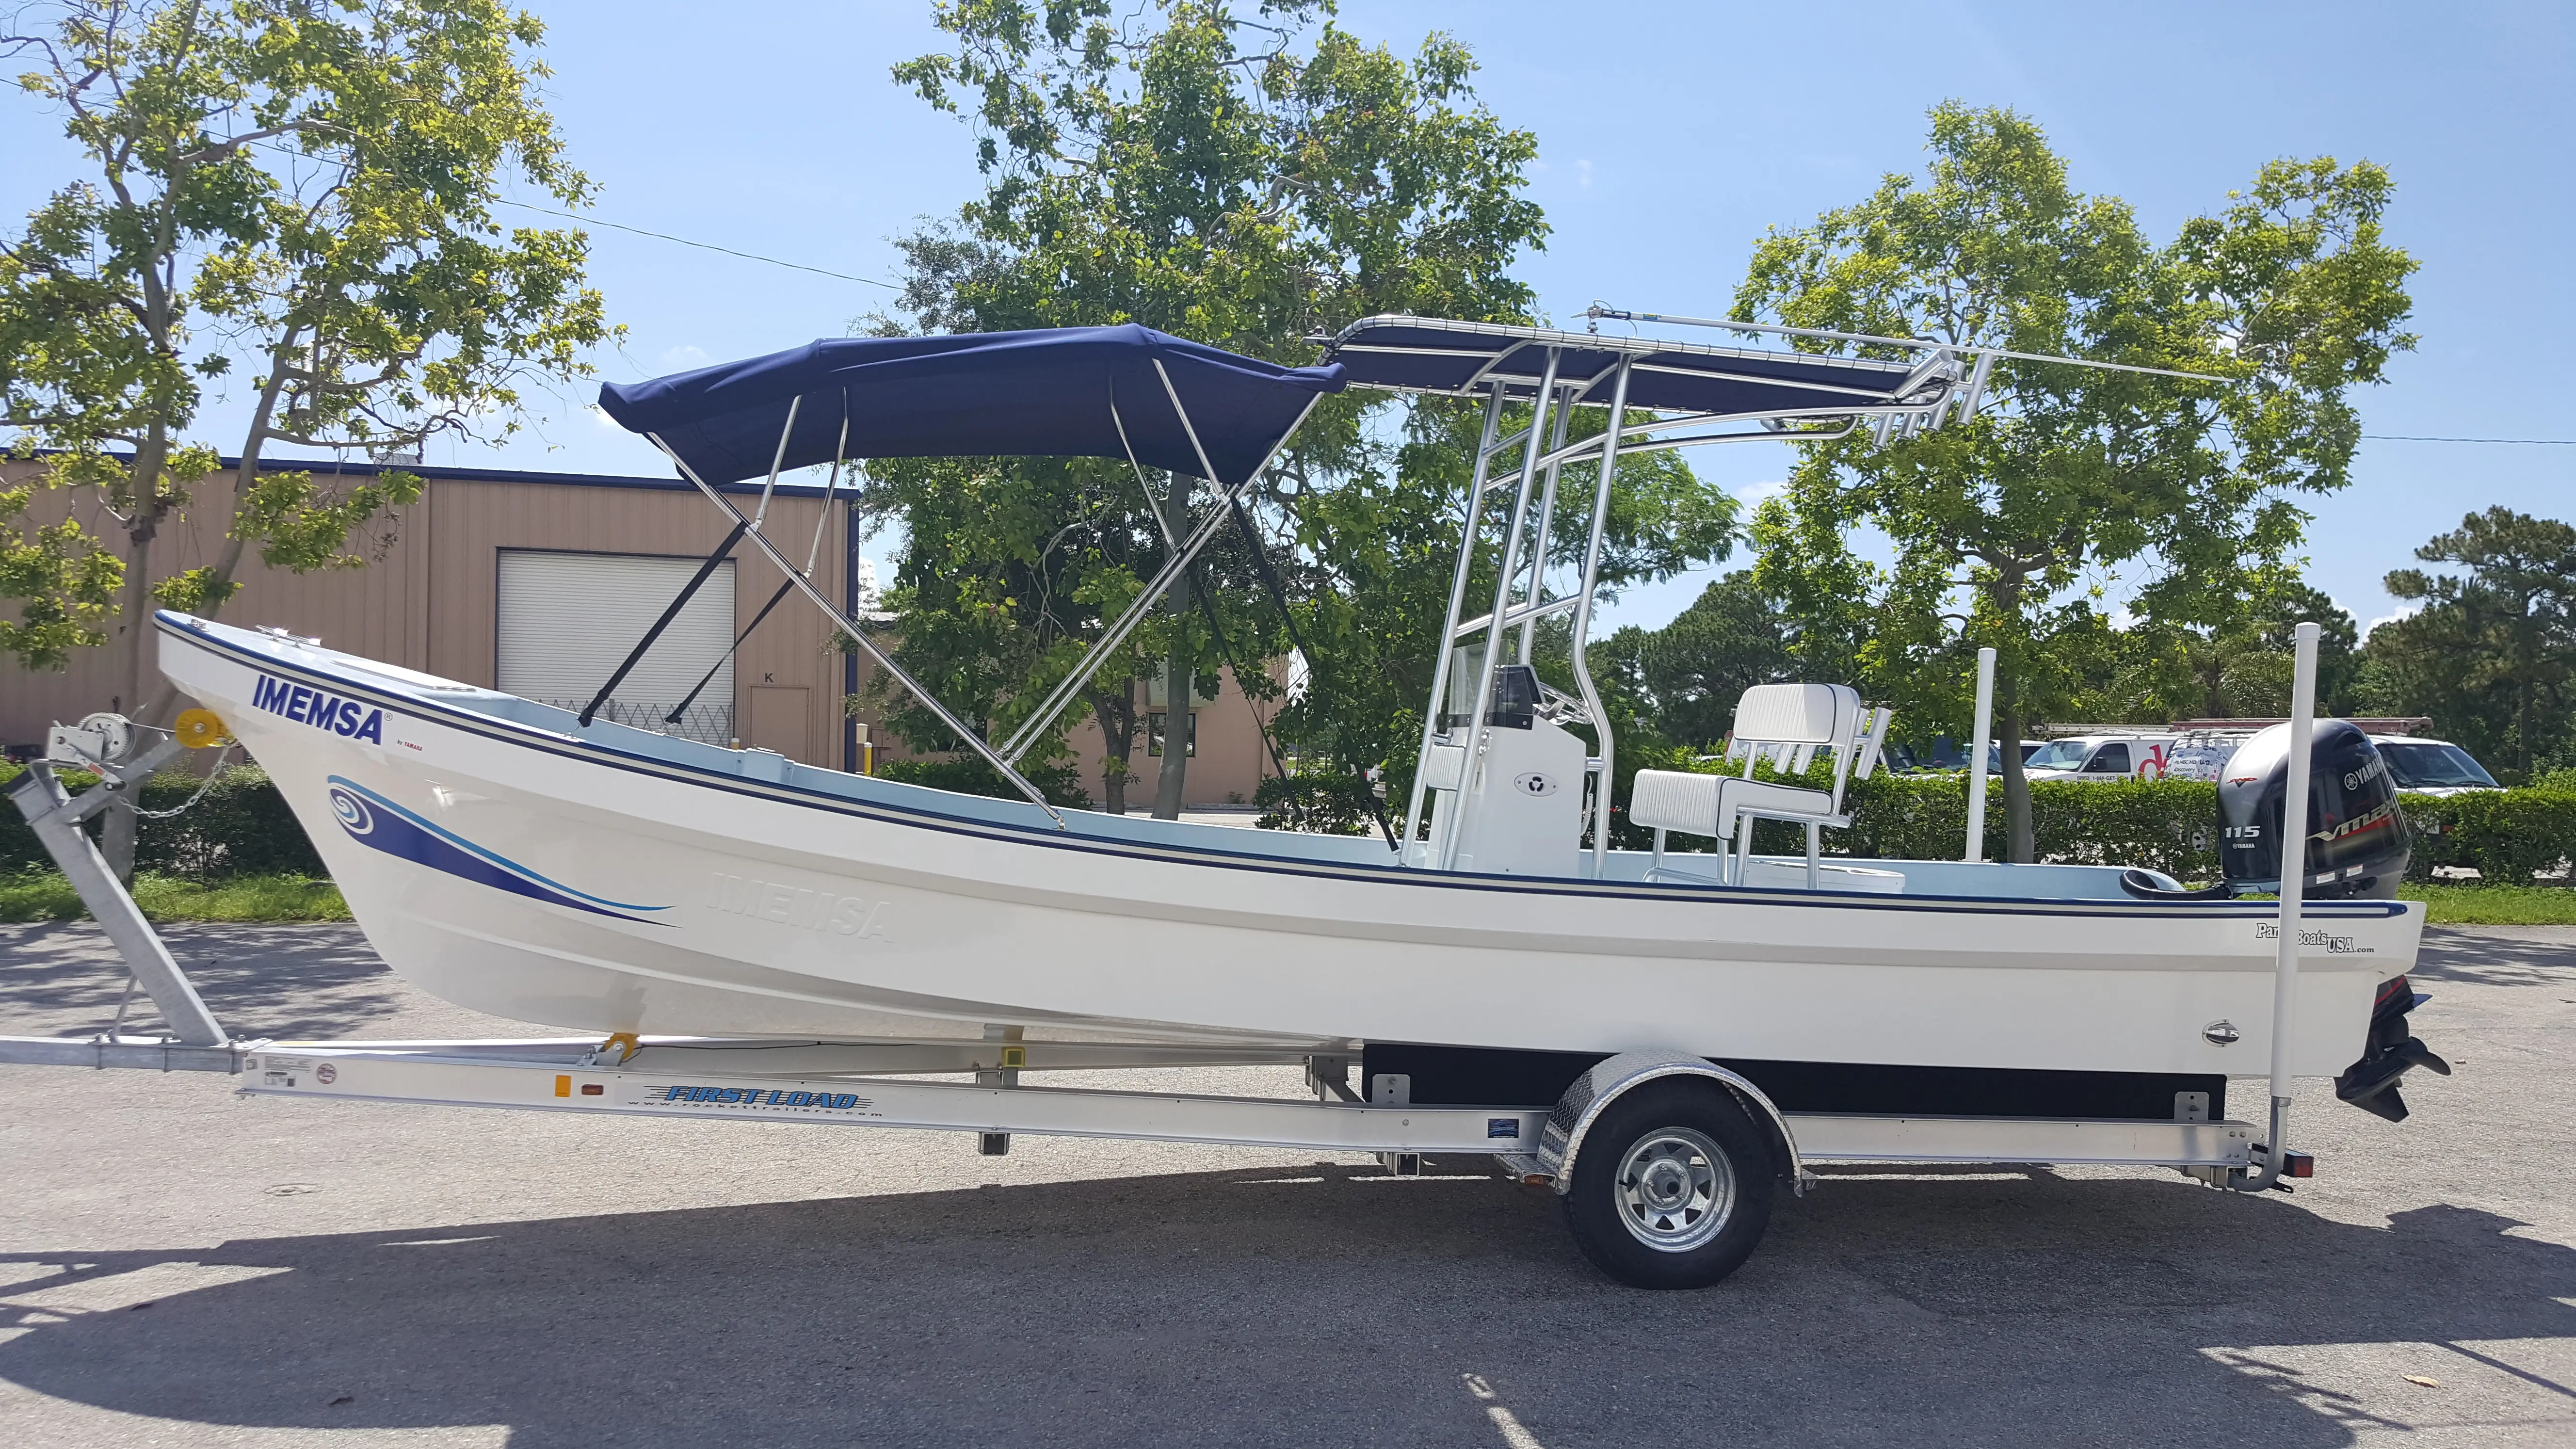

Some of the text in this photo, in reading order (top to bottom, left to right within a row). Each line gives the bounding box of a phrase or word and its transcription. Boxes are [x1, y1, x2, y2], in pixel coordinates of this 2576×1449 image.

[765, 673, 773, 683] K
[404, 741, 422, 751] YAMAHA
[2225, 826, 2260, 838] 115
[705, 872, 895, 943] IMEMSA
[665, 1085, 858, 1109] FIRST LOAD
